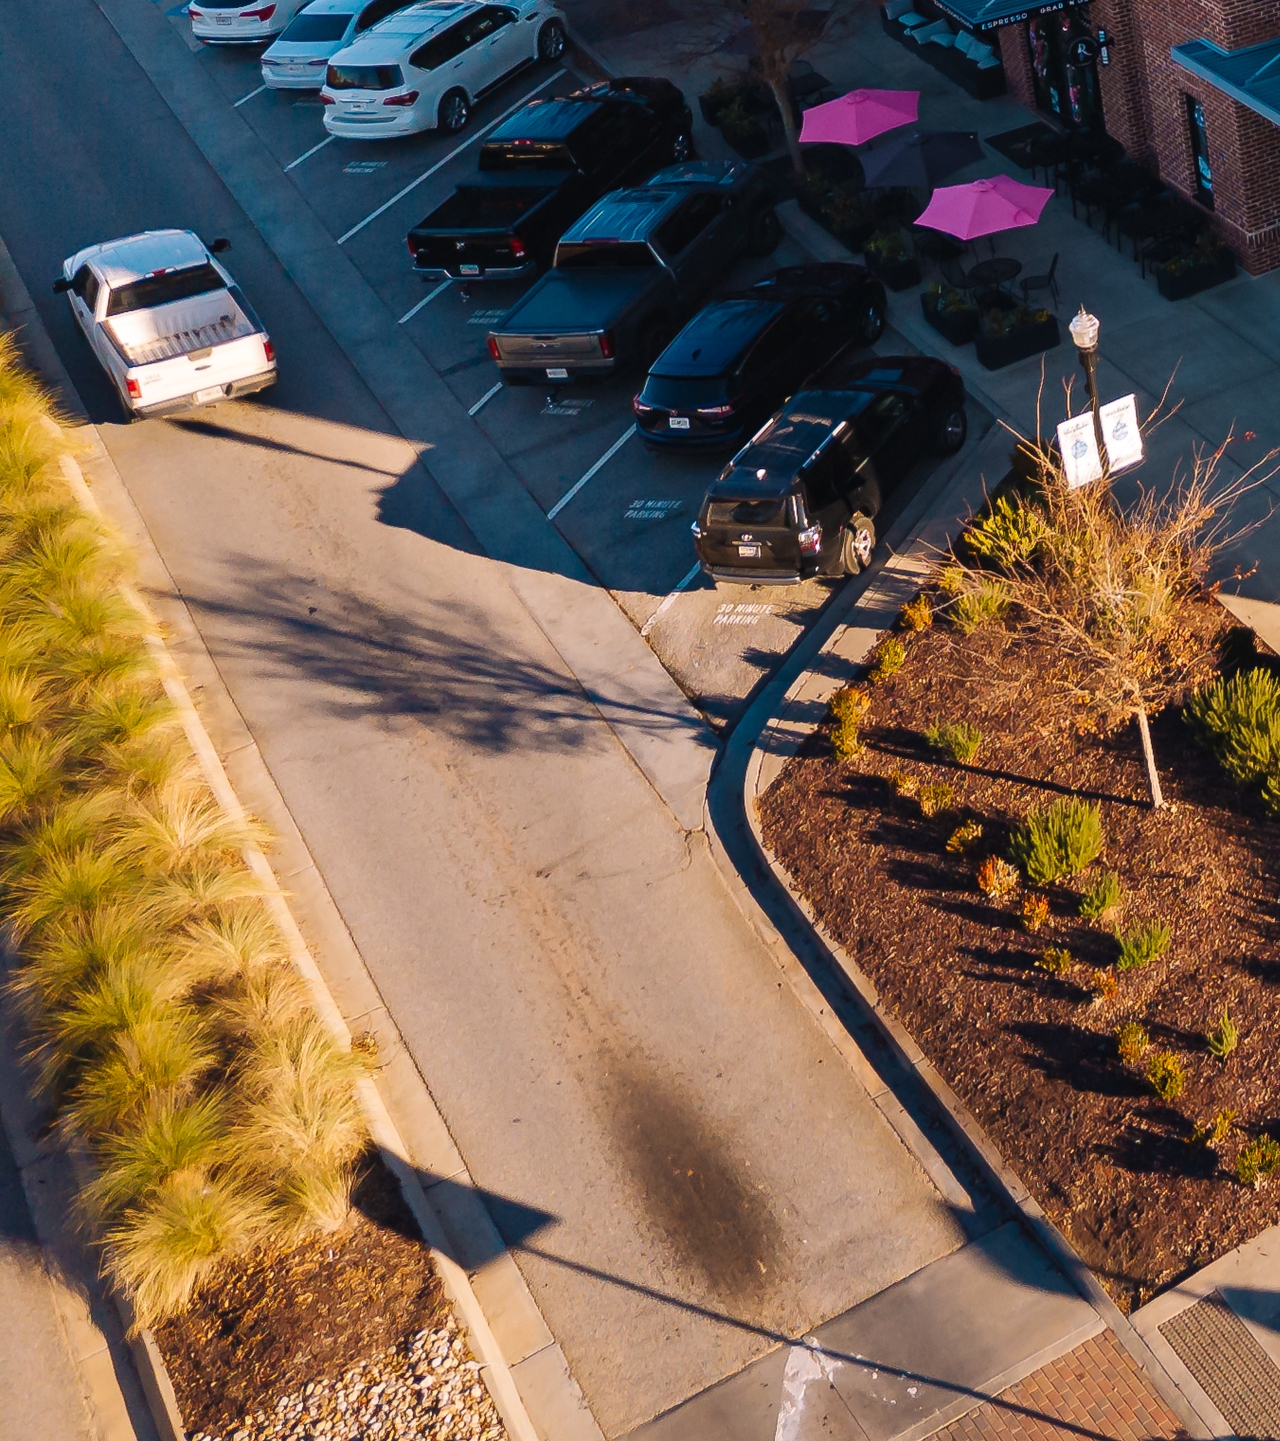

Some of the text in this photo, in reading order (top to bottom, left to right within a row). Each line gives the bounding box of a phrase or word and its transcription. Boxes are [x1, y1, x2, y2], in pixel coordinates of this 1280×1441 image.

[981, 12, 1028, 31] ESPRESSO
[629, 500, 682, 509] 30 MINUTE
[623, 509, 667, 519] PARKING
[717, 603, 775, 615] 30 MINUTE
[713, 614, 760, 625] PARKING
